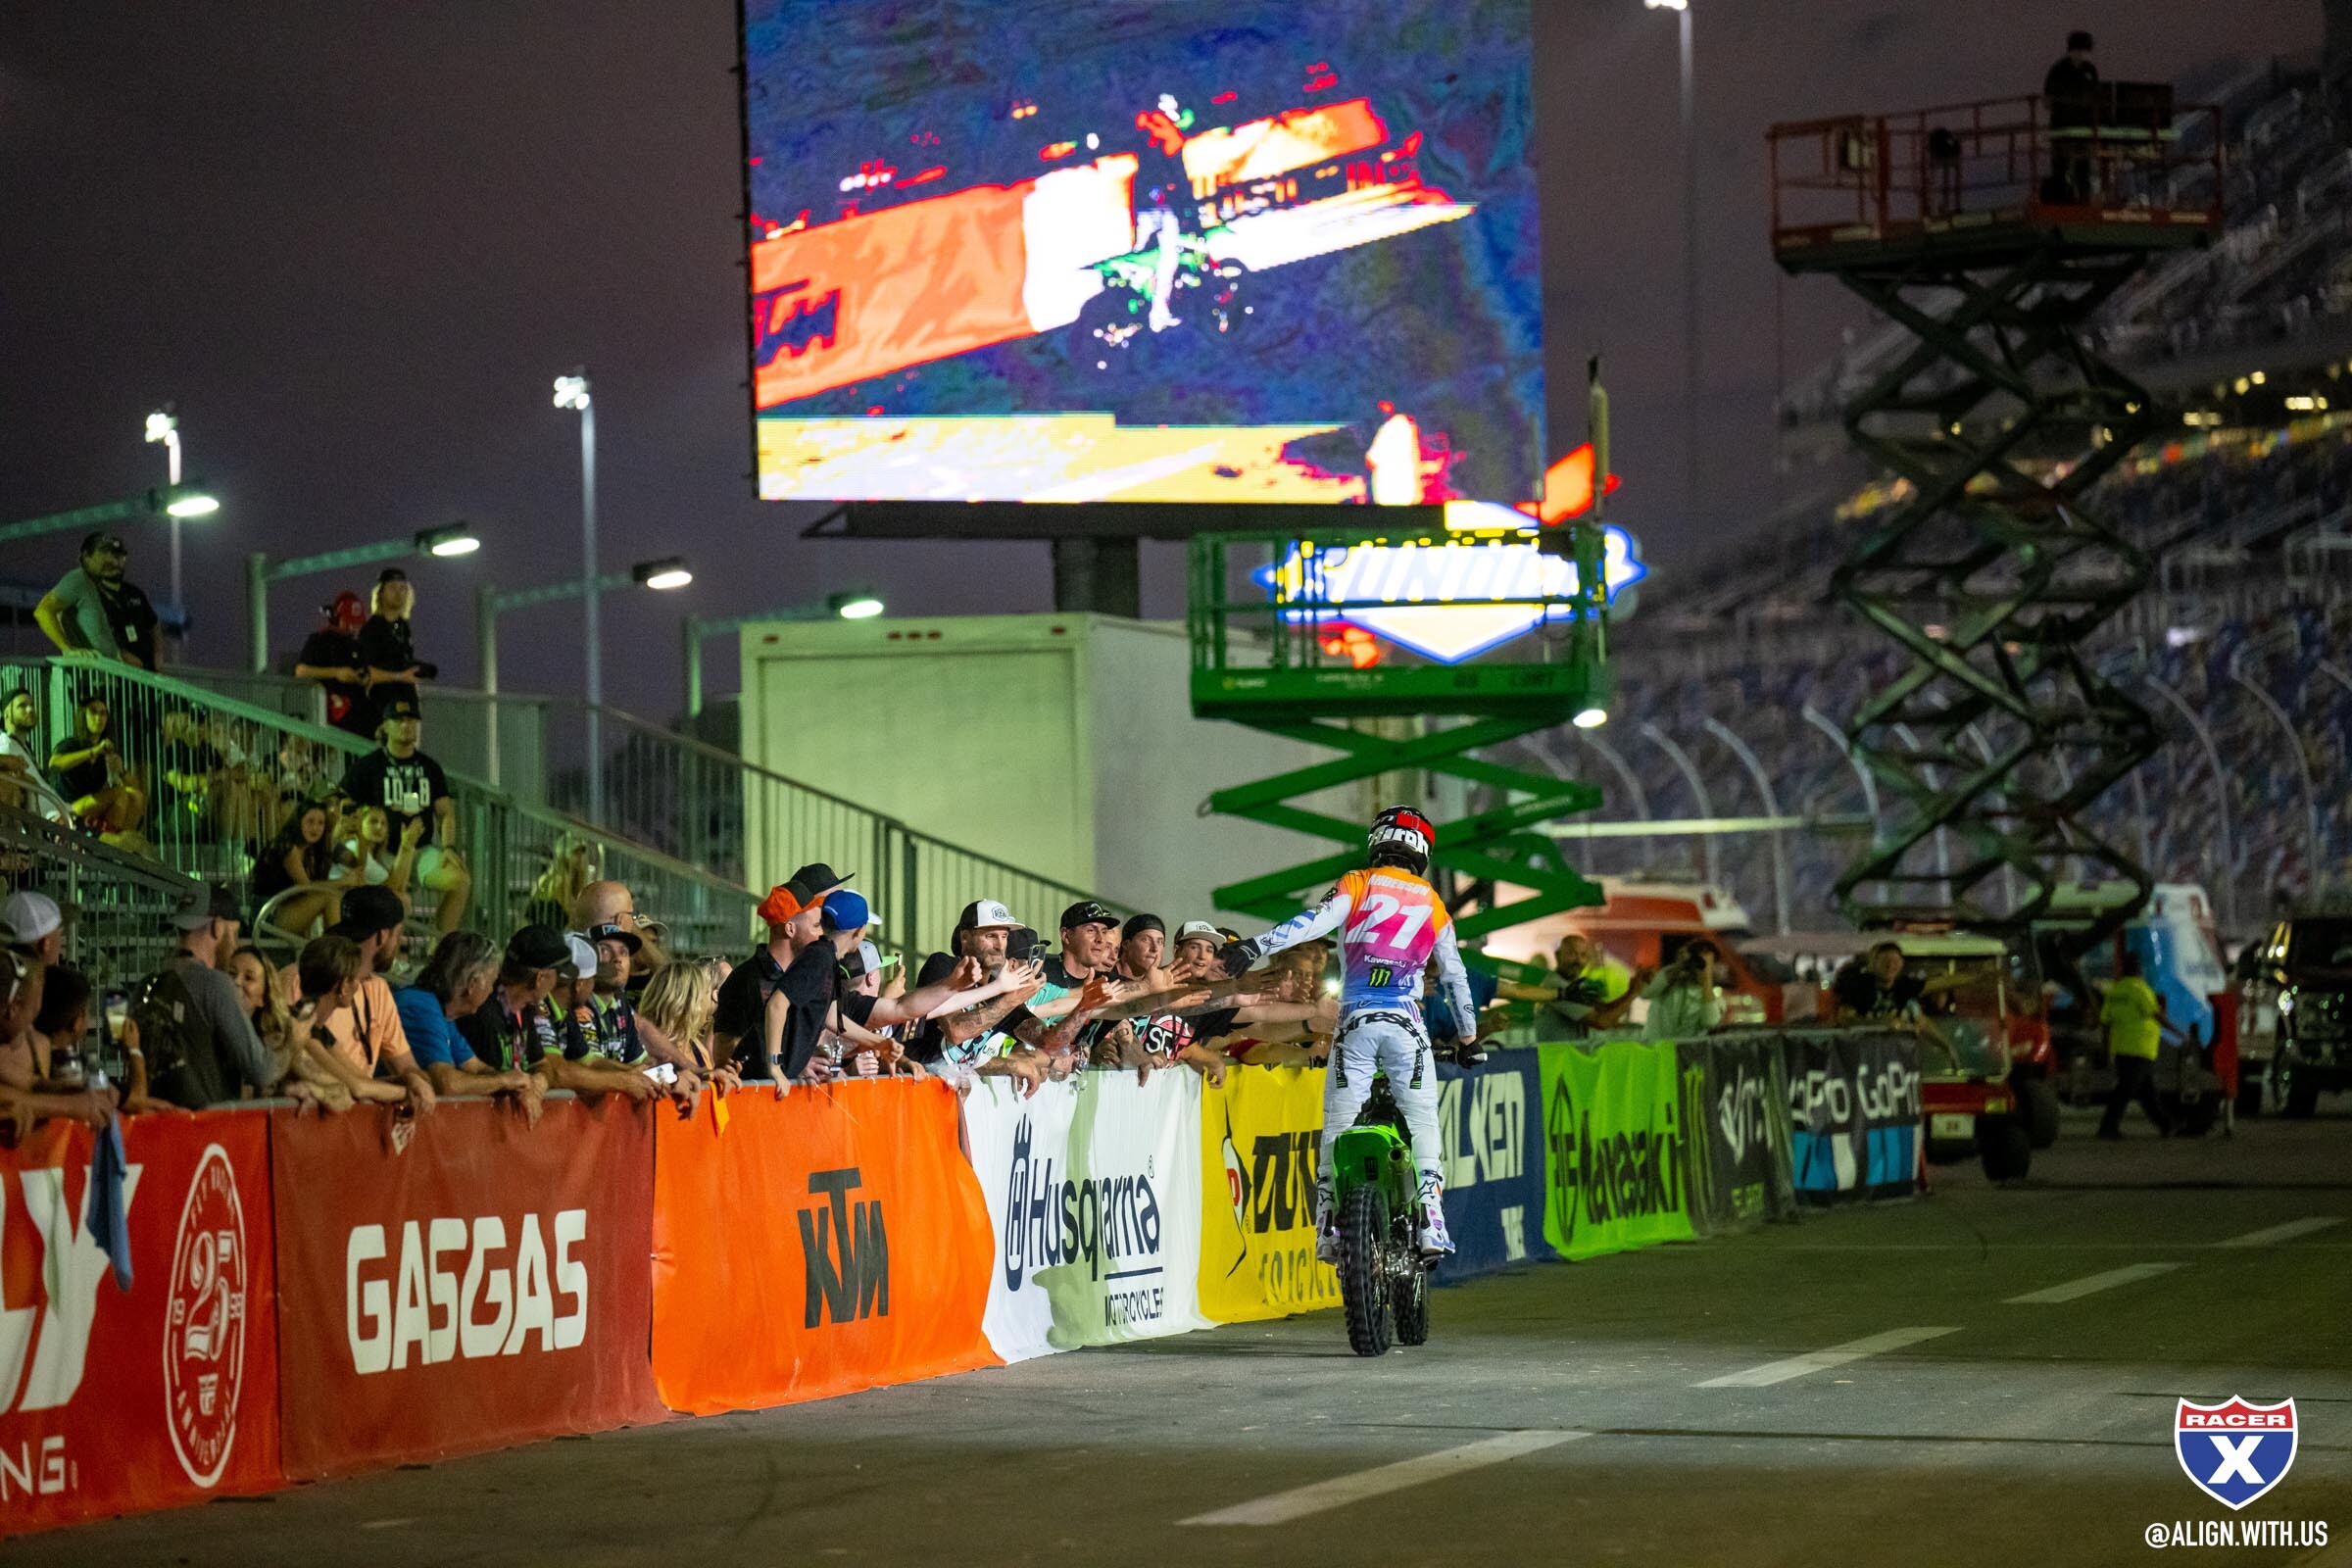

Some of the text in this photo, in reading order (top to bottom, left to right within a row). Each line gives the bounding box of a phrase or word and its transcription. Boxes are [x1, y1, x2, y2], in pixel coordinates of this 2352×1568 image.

[1346, 894, 1433, 950] 21
[1369, 874, 1430, 896] ANDERSON
[1364, 955, 1407, 968] Kawasaki
[1252, 1129, 1323, 1233] DUN
[1438, 1071, 1526, 1191] ALKEN
[347, 1209, 588, 1374] GASGAS
[797, 1167, 888, 1328] KTM
